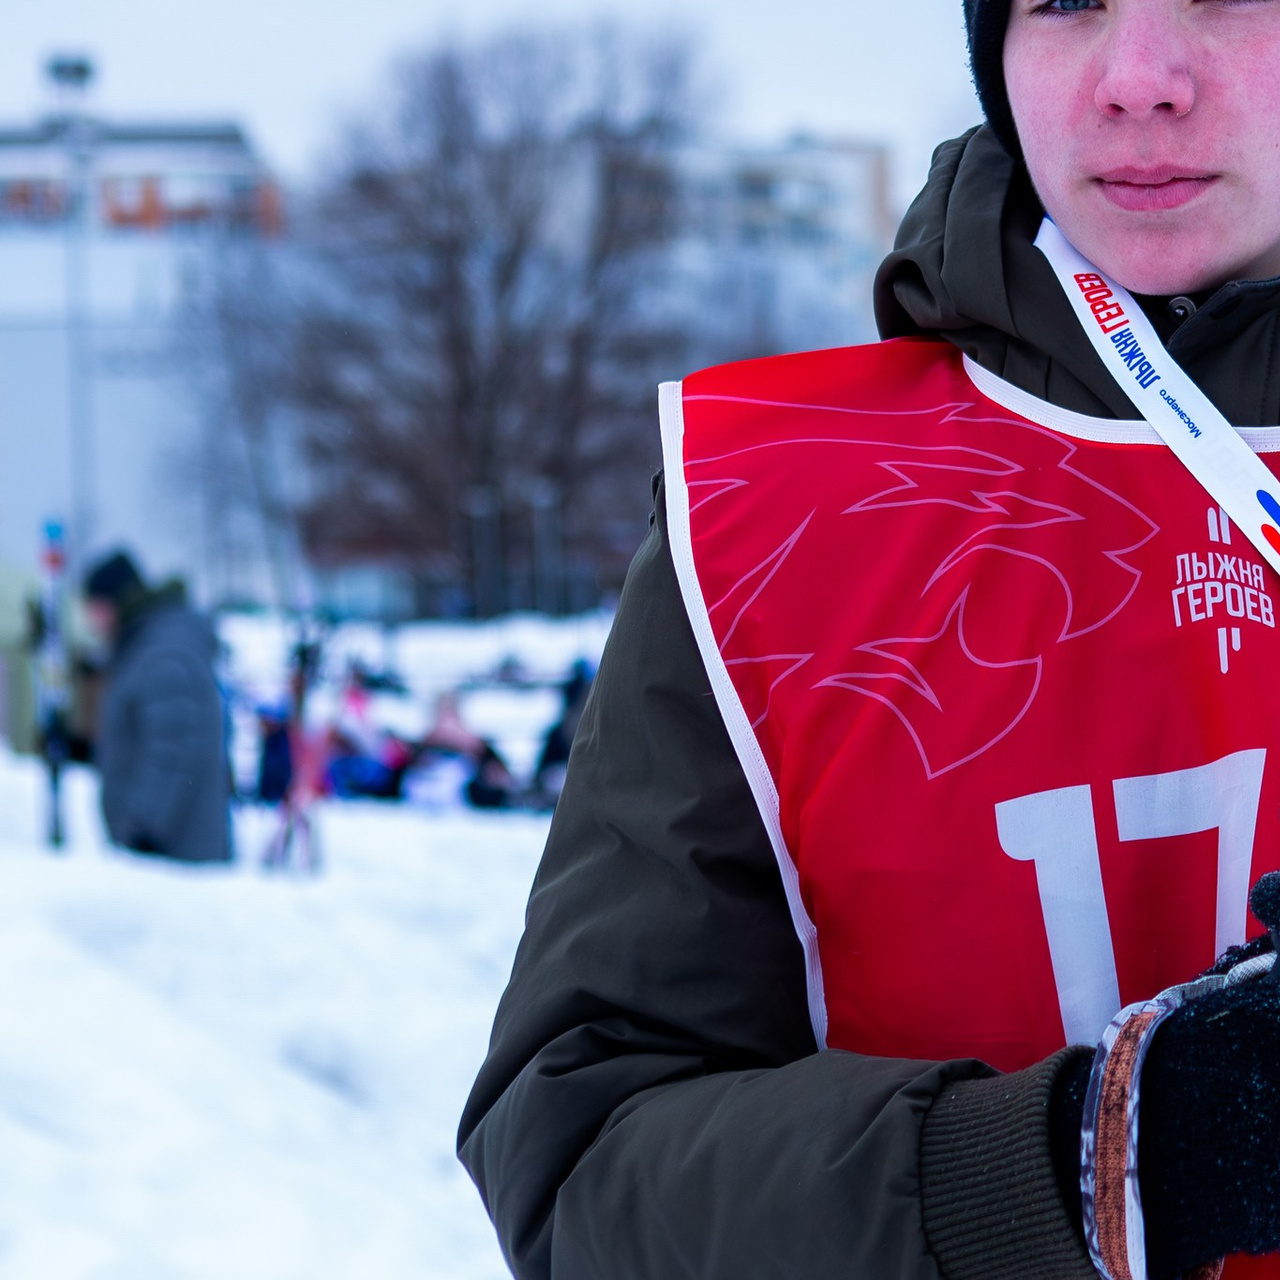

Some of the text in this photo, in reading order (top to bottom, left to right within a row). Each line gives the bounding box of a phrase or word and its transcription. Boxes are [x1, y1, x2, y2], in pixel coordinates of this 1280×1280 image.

[1073, 272, 1202, 438] Мосэнерго ЛЫЖНЯ ГЕРОЕВ
[1176, 551, 1265, 591] ЛЫЖНЯ
[1171, 581, 1275, 628] ГЕРОЕВ
